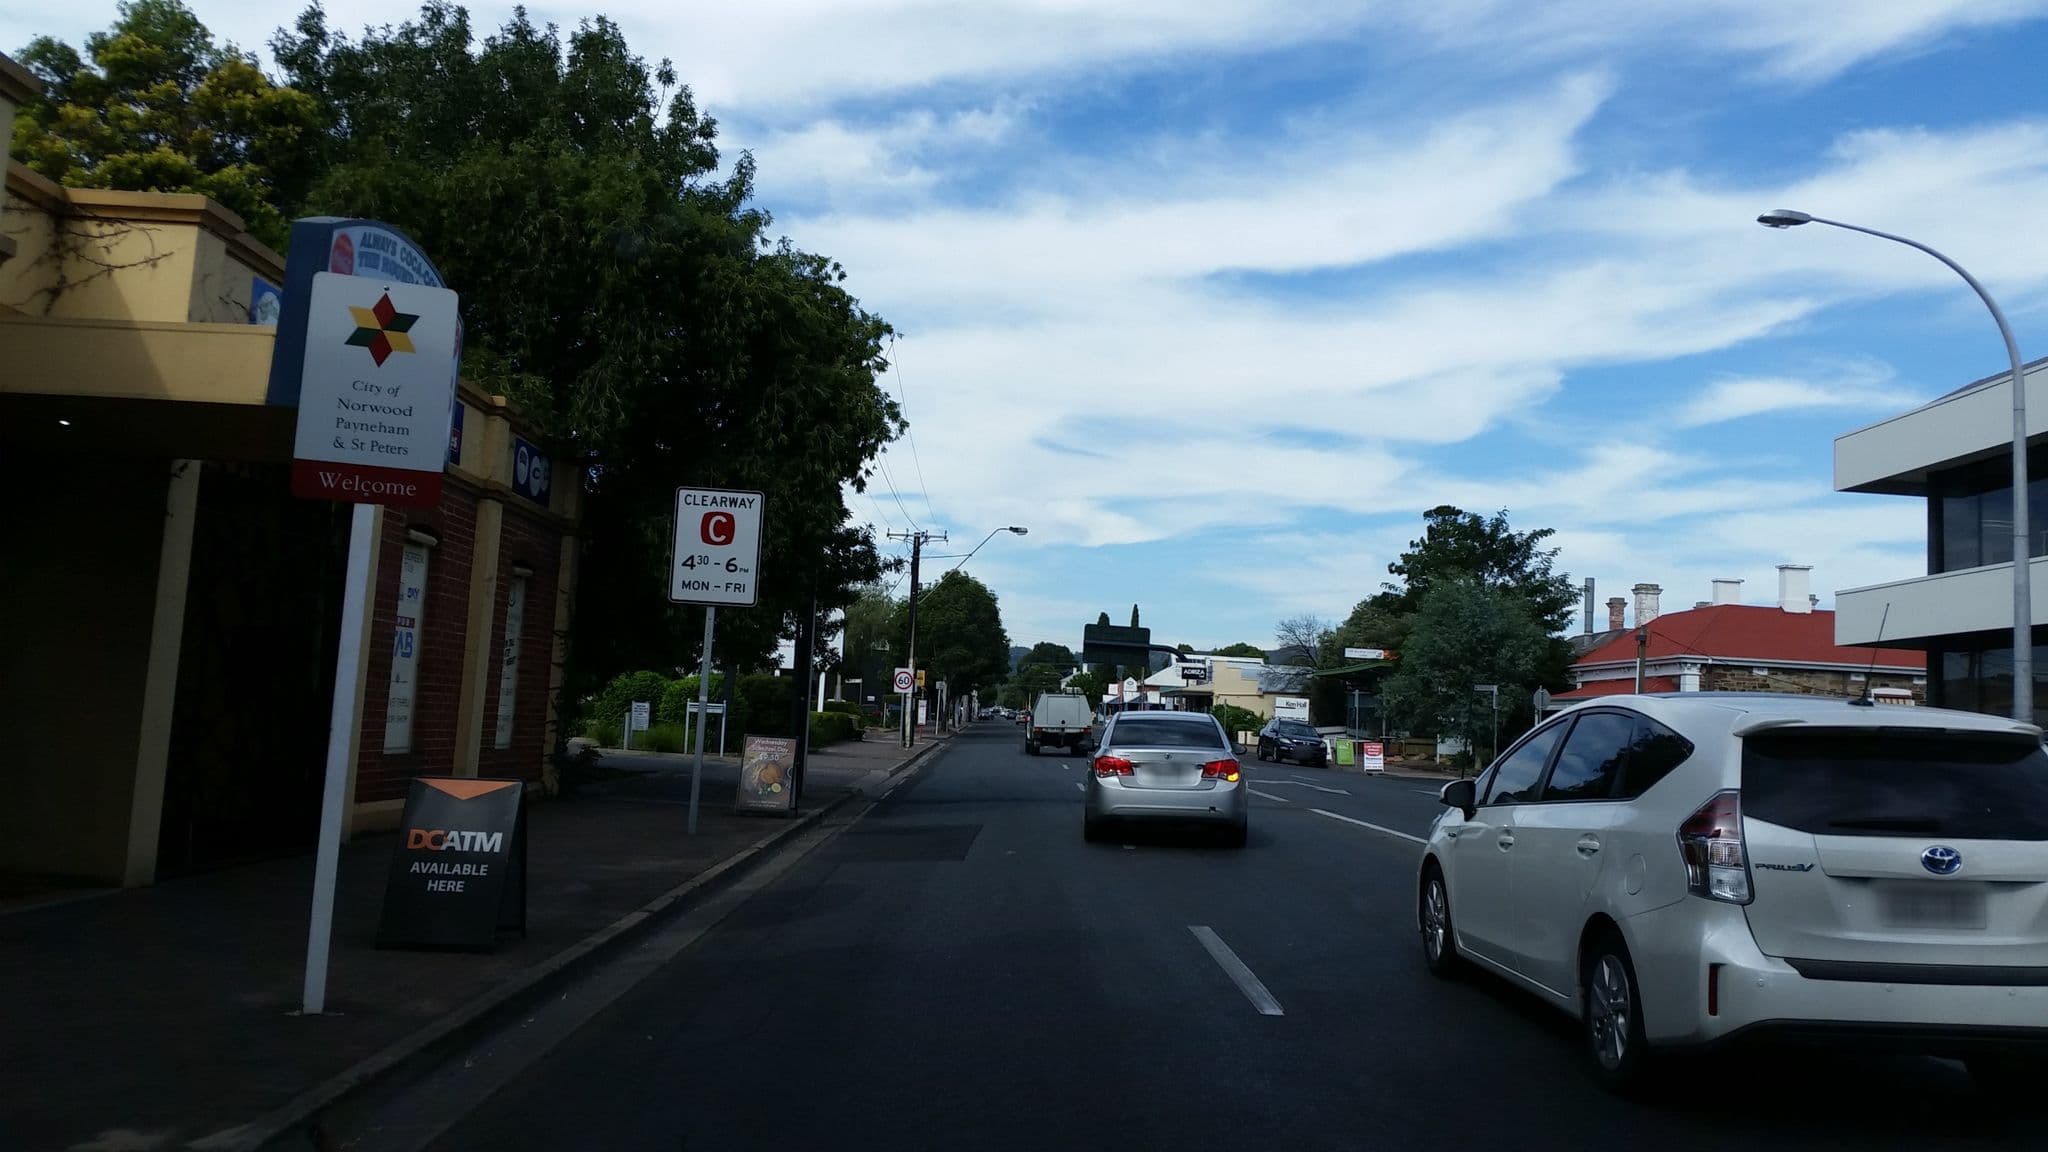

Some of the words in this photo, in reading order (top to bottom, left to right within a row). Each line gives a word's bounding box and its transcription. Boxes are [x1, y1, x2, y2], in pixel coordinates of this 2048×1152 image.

[360, 232, 397, 256] ALWAYS
[400, 246, 438, 287] COCA-CO
[352, 380, 382, 396] City
[387, 384, 401, 397] of
[338, 397, 413, 417] Norwood
[335, 417, 410, 436] Payneham
[333, 437, 345, 449] &
[351, 438, 366, 451] St
[370, 440, 409, 455] Peters
[319, 471, 417, 496] Welcome
[684, 494, 756, 509] CLEARWAY
[708, 515, 728, 543] C
[681, 580, 710, 591] MON
[725, 582, 746, 593] FRI
[898, 676, 910, 685] 60
[410, 861, 489, 877] AVAILABLE
[427, 879, 465, 893] HERE
